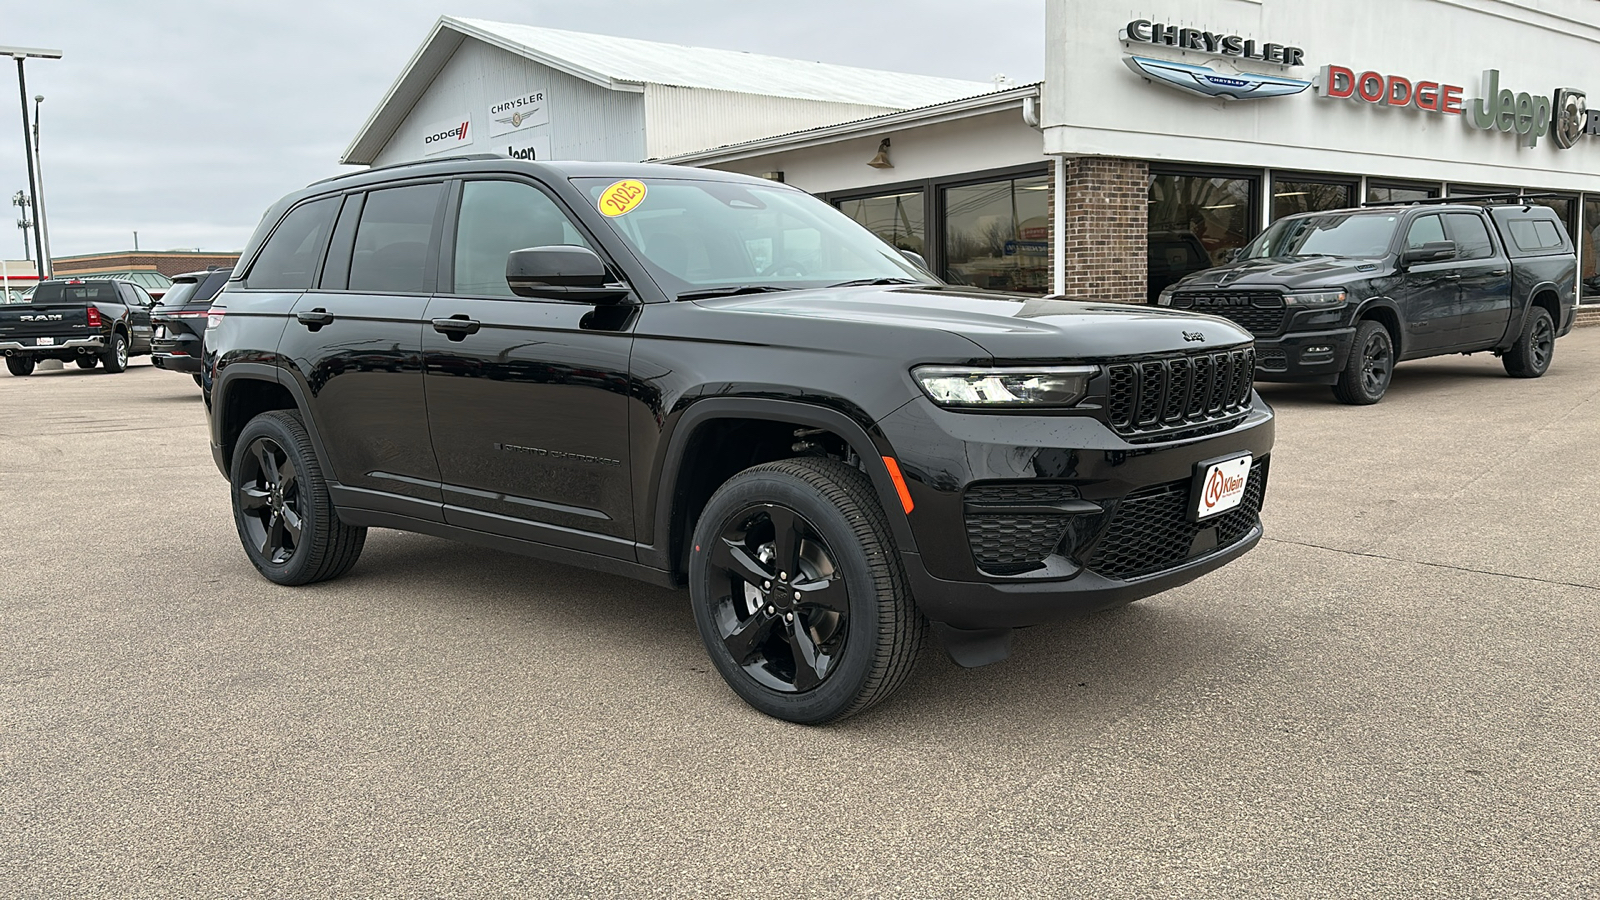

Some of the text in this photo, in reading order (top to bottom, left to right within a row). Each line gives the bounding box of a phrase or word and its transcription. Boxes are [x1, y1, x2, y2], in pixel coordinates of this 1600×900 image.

[1127, 19, 1304, 66] CHRYSLER
[1209, 77, 1244, 86] CHRYSLER
[1320, 64, 1463, 115] DODGE
[491, 93, 543, 114] CHRYSLER
[1466, 69, 1550, 148] Jeep
[425, 128, 462, 144] DODGE
[606, 182, 641, 212] 2025
[1195, 296, 1249, 306] RAM
[20, 314, 63, 322] RAM
[1182, 330, 1205, 342] Jeep
[505, 444, 548, 457] GRAND
[1223, 474, 1243, 494] Klein
